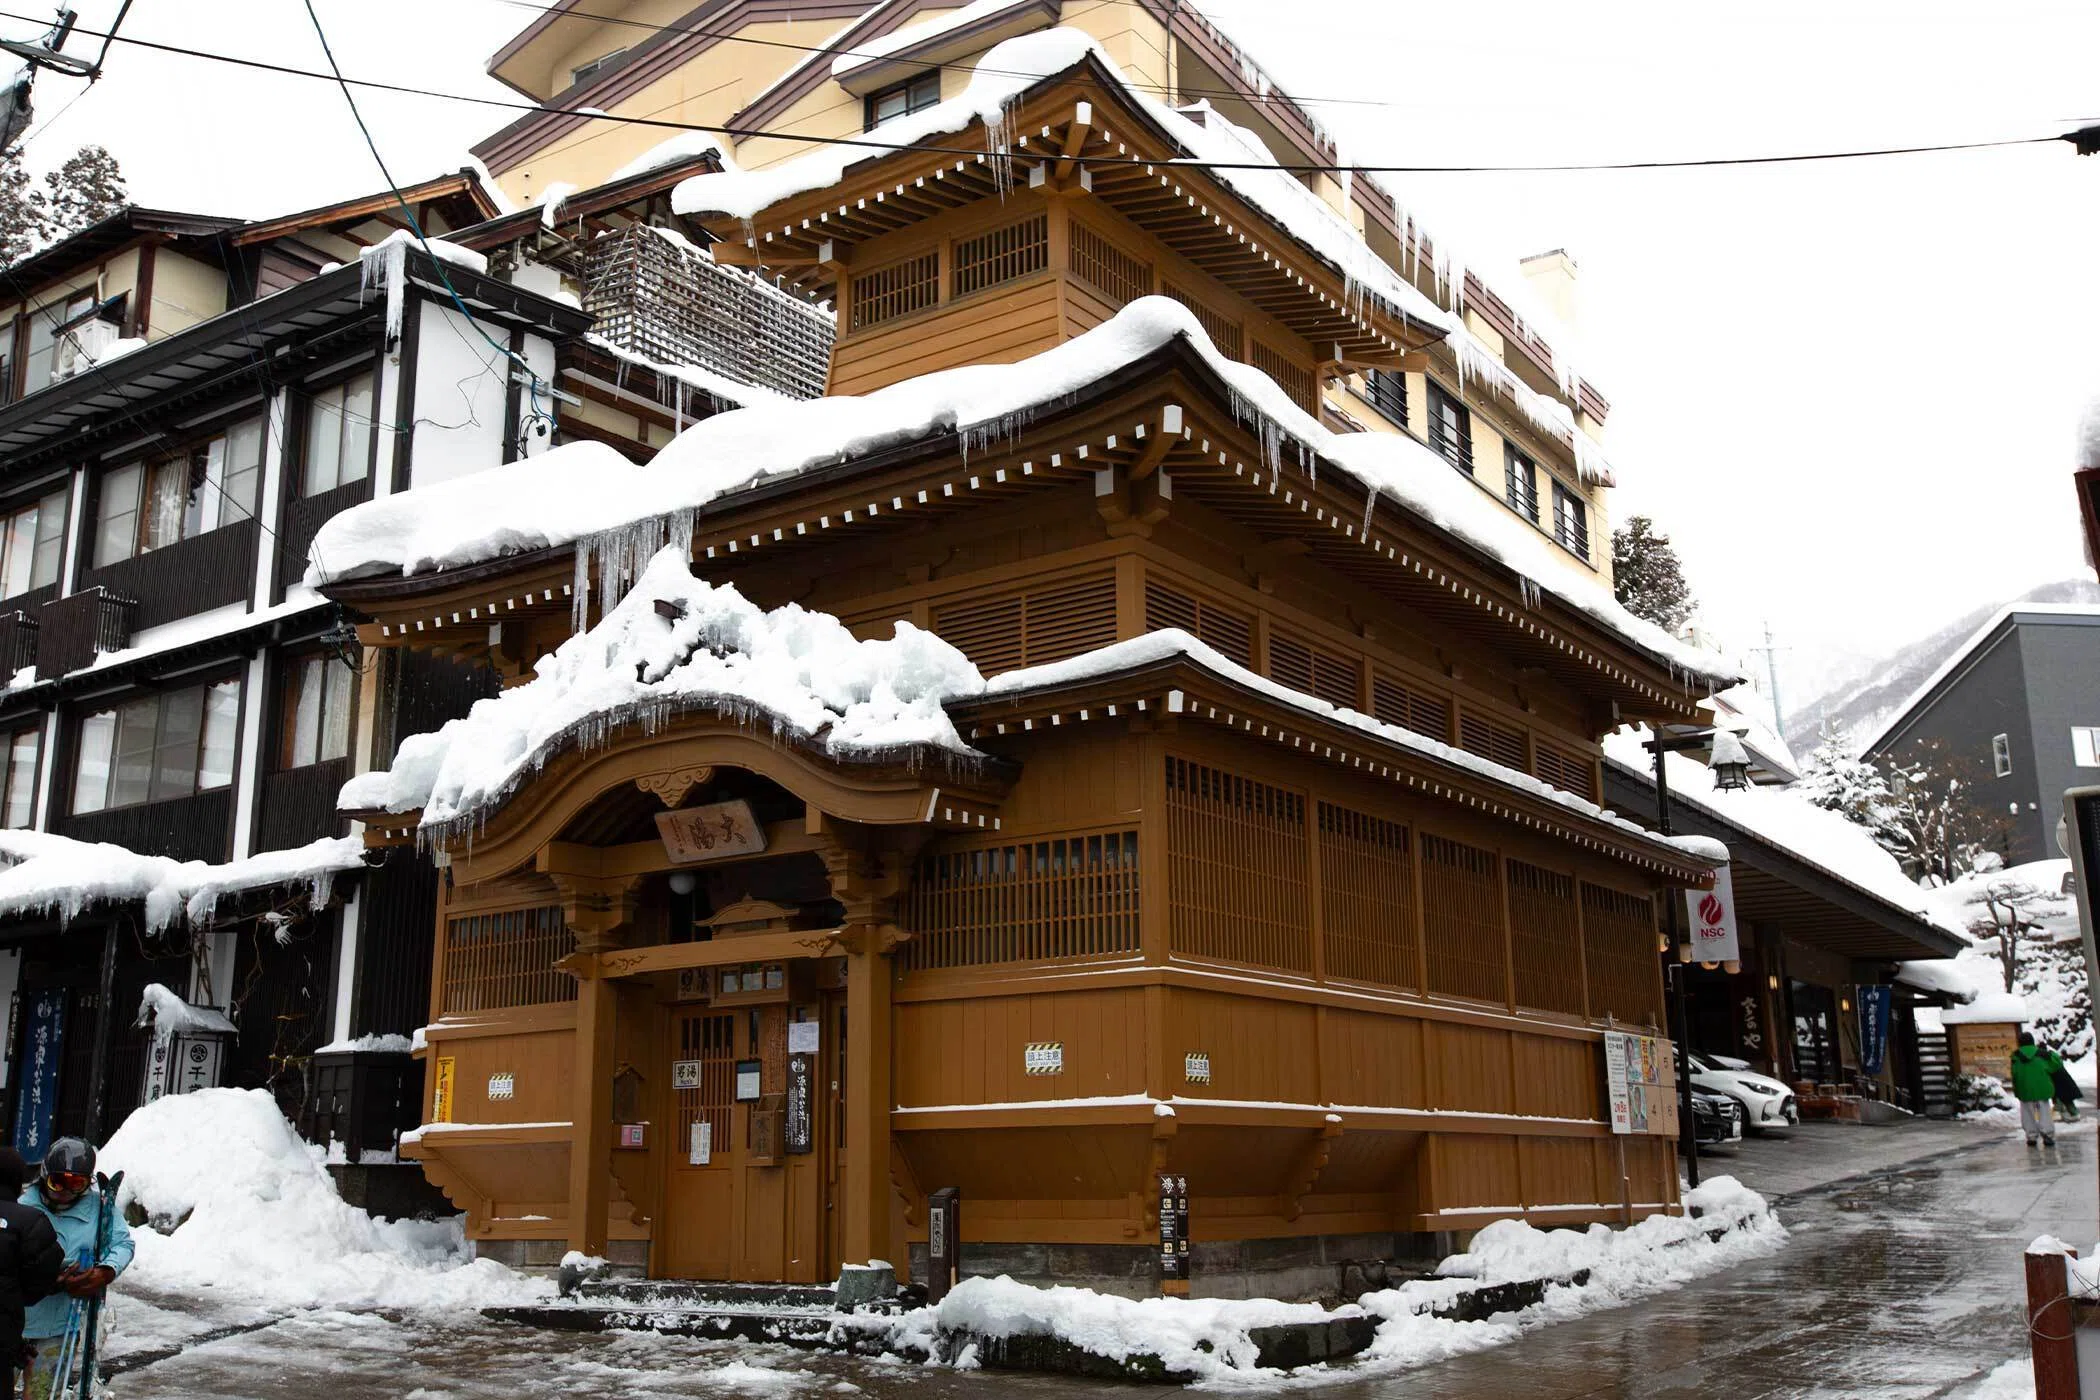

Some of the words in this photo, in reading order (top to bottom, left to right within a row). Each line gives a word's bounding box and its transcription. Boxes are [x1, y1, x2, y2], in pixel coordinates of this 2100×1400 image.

[1700, 927, 1725, 937] NSC
[1027, 1050, 1060, 1061] 頭上注意
[677, 1064, 697, 1079] 男湯
